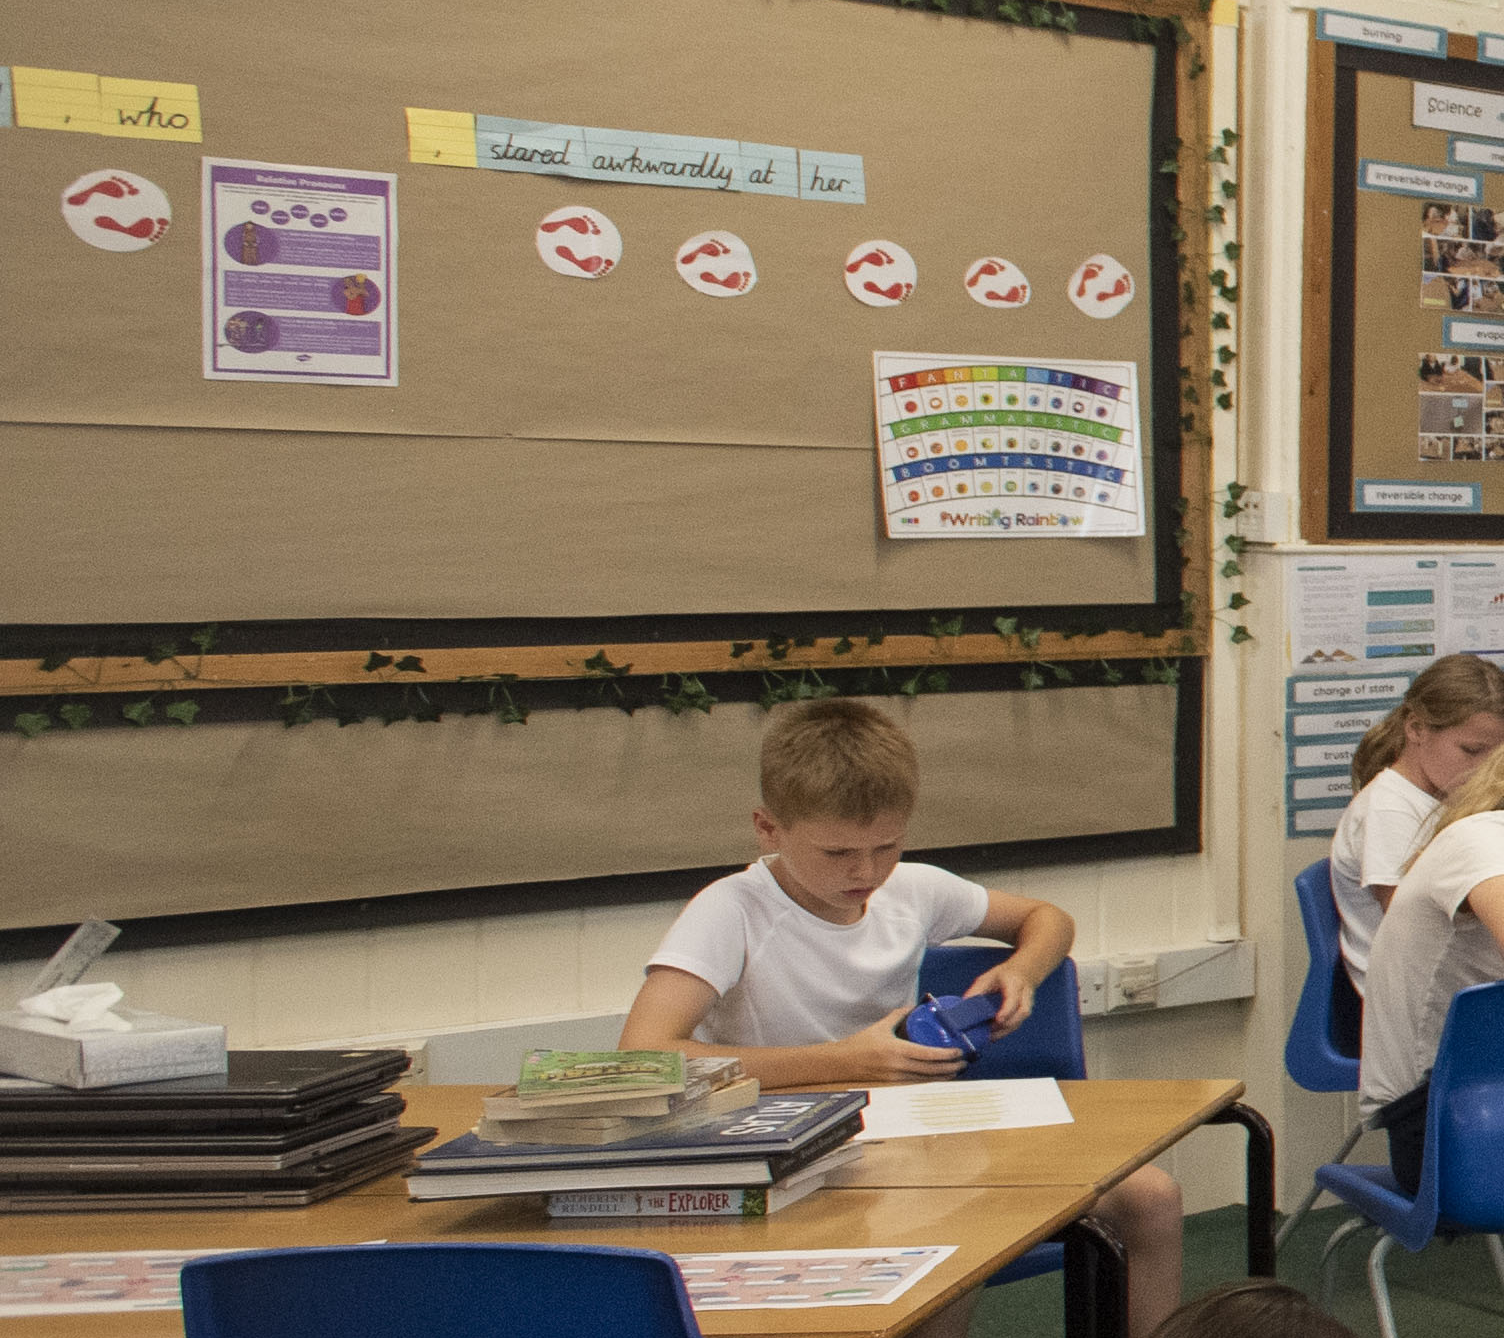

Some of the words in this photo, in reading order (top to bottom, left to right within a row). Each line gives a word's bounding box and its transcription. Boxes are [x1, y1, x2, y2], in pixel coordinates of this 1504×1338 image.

[118, 97, 189, 129] who
[1428, 97, 1483, 118] Science
[491, 134, 571, 166] stared
[592, 147, 734, 189] awkwardly
[749, 160, 774, 185] at
[648, 1196, 666, 1209] THE
[668, 1193, 732, 1213] EXPLORER
